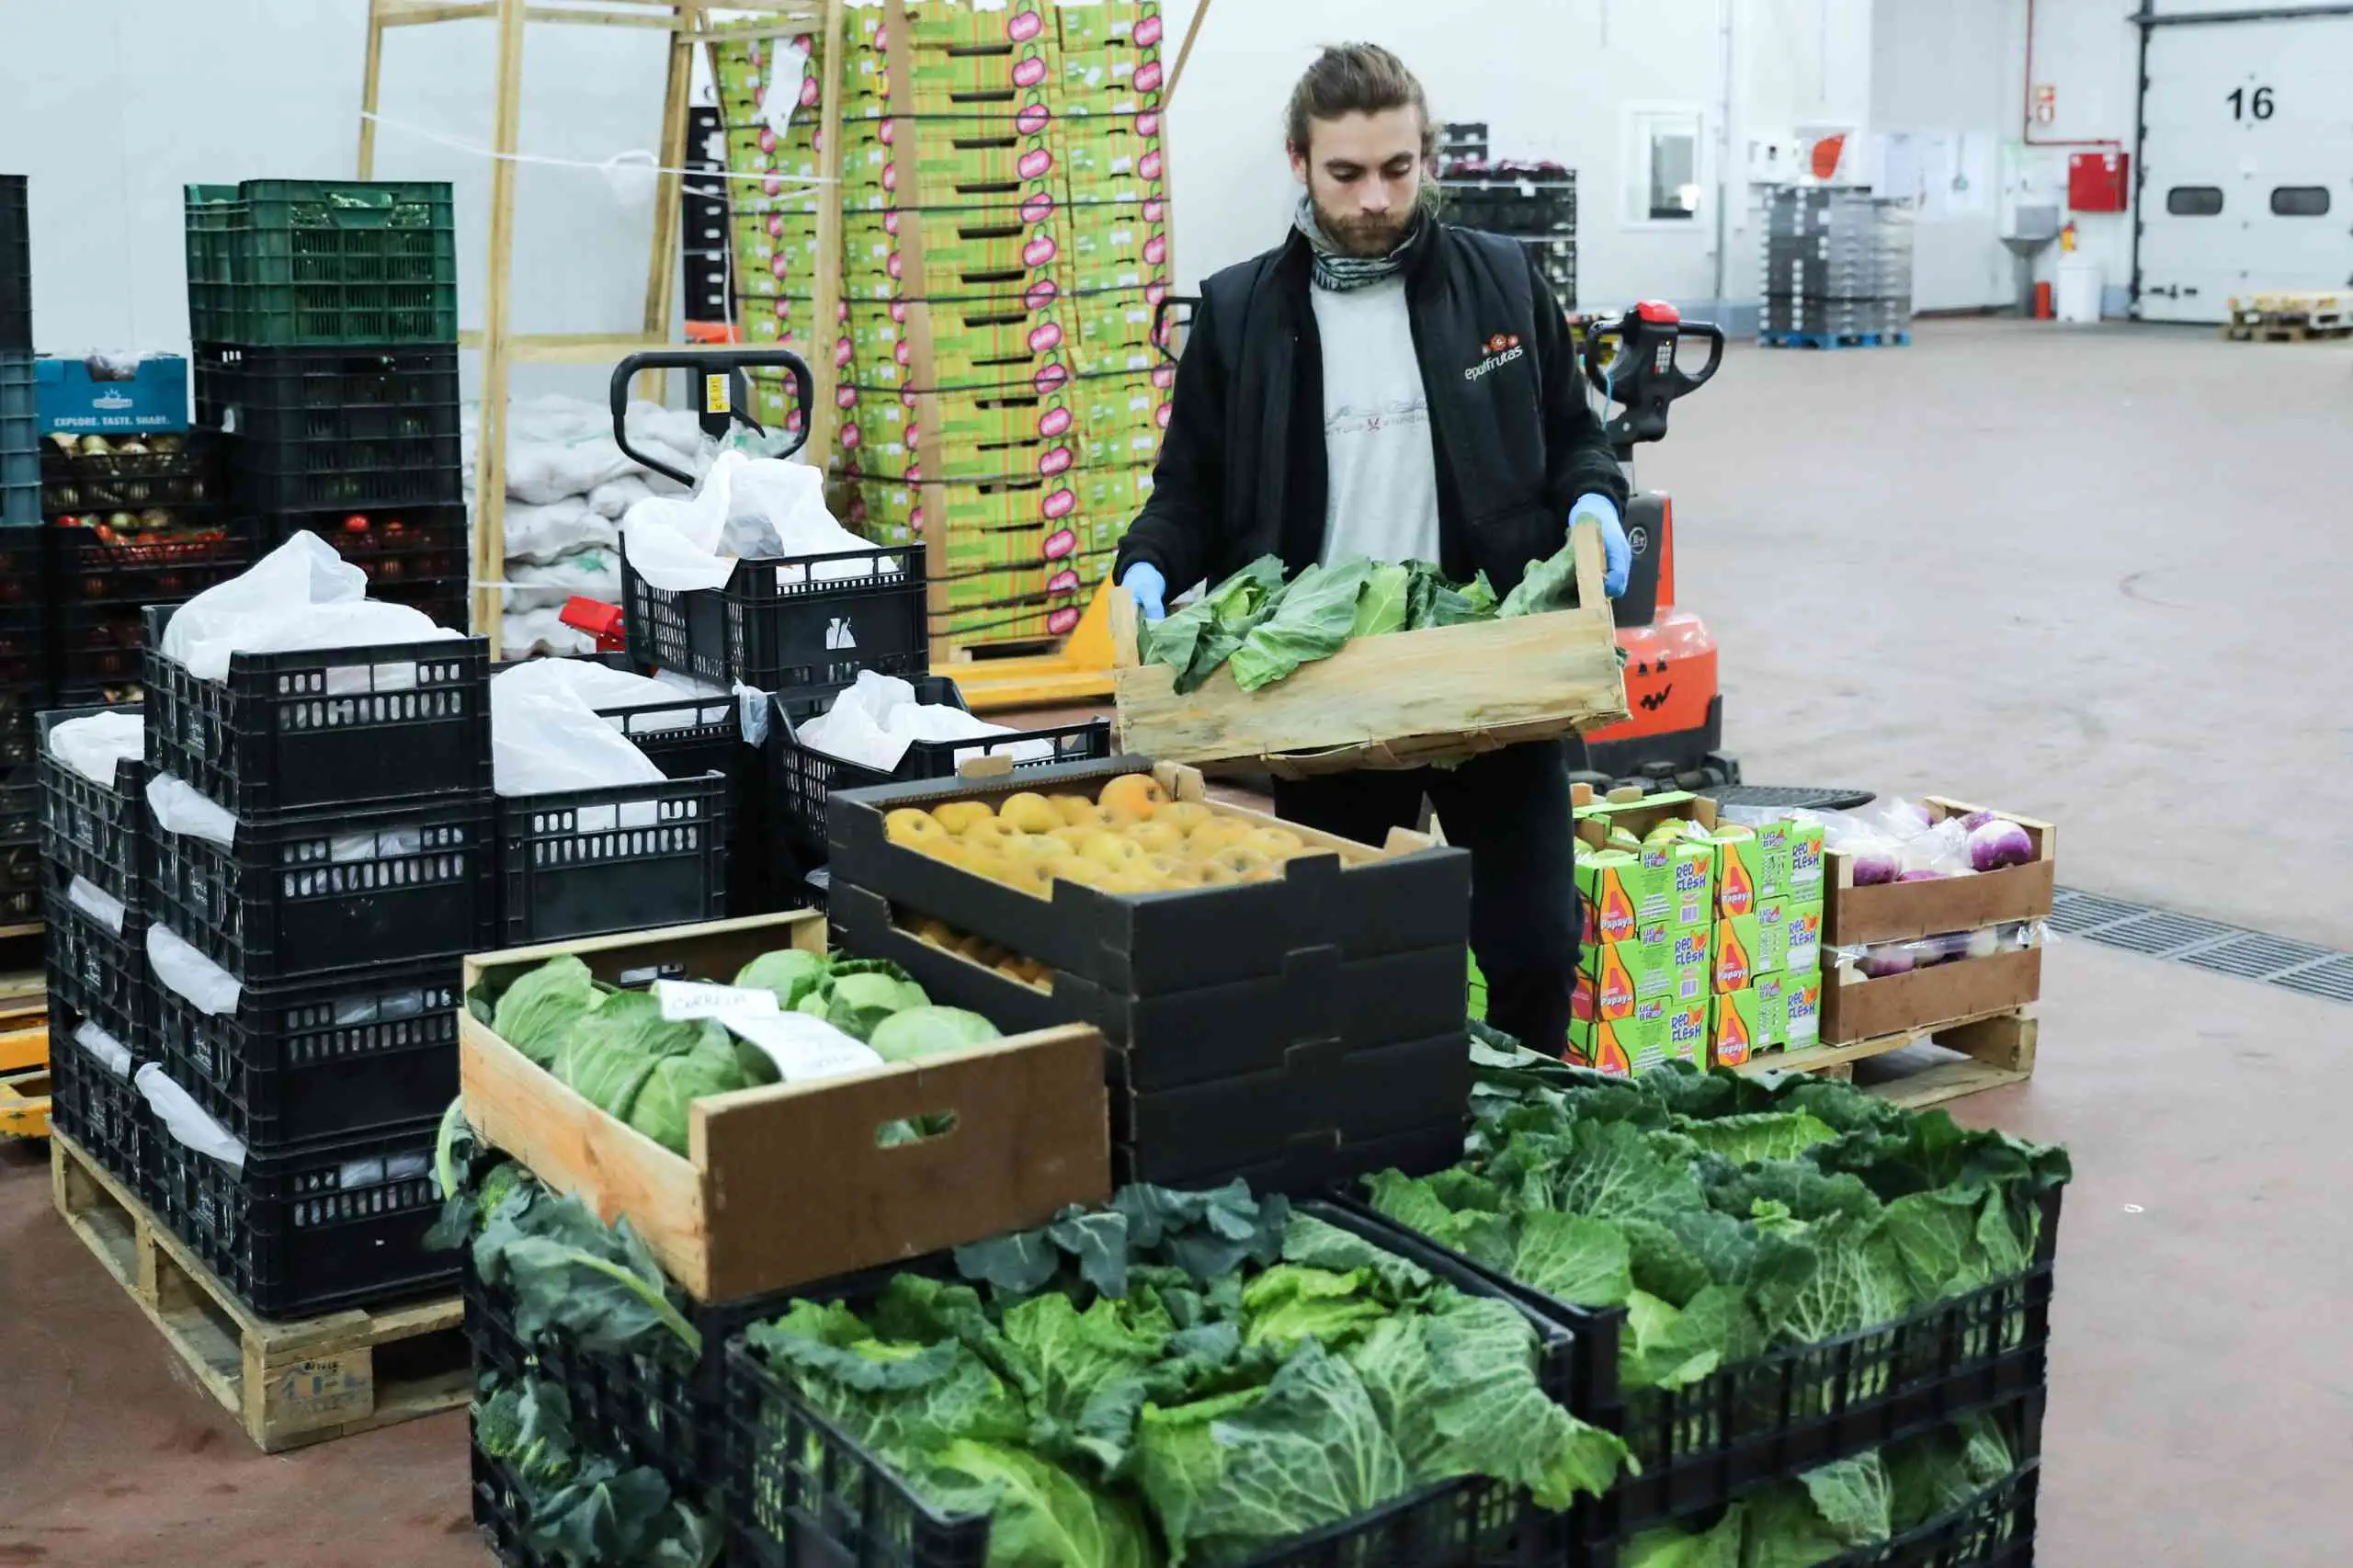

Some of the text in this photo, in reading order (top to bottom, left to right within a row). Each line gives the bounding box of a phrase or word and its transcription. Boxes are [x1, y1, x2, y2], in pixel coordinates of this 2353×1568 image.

[2226, 87, 2275, 120] 16
[53, 416, 100, 426] EXPLORE.
[102, 415, 133, 426] TASTE.
